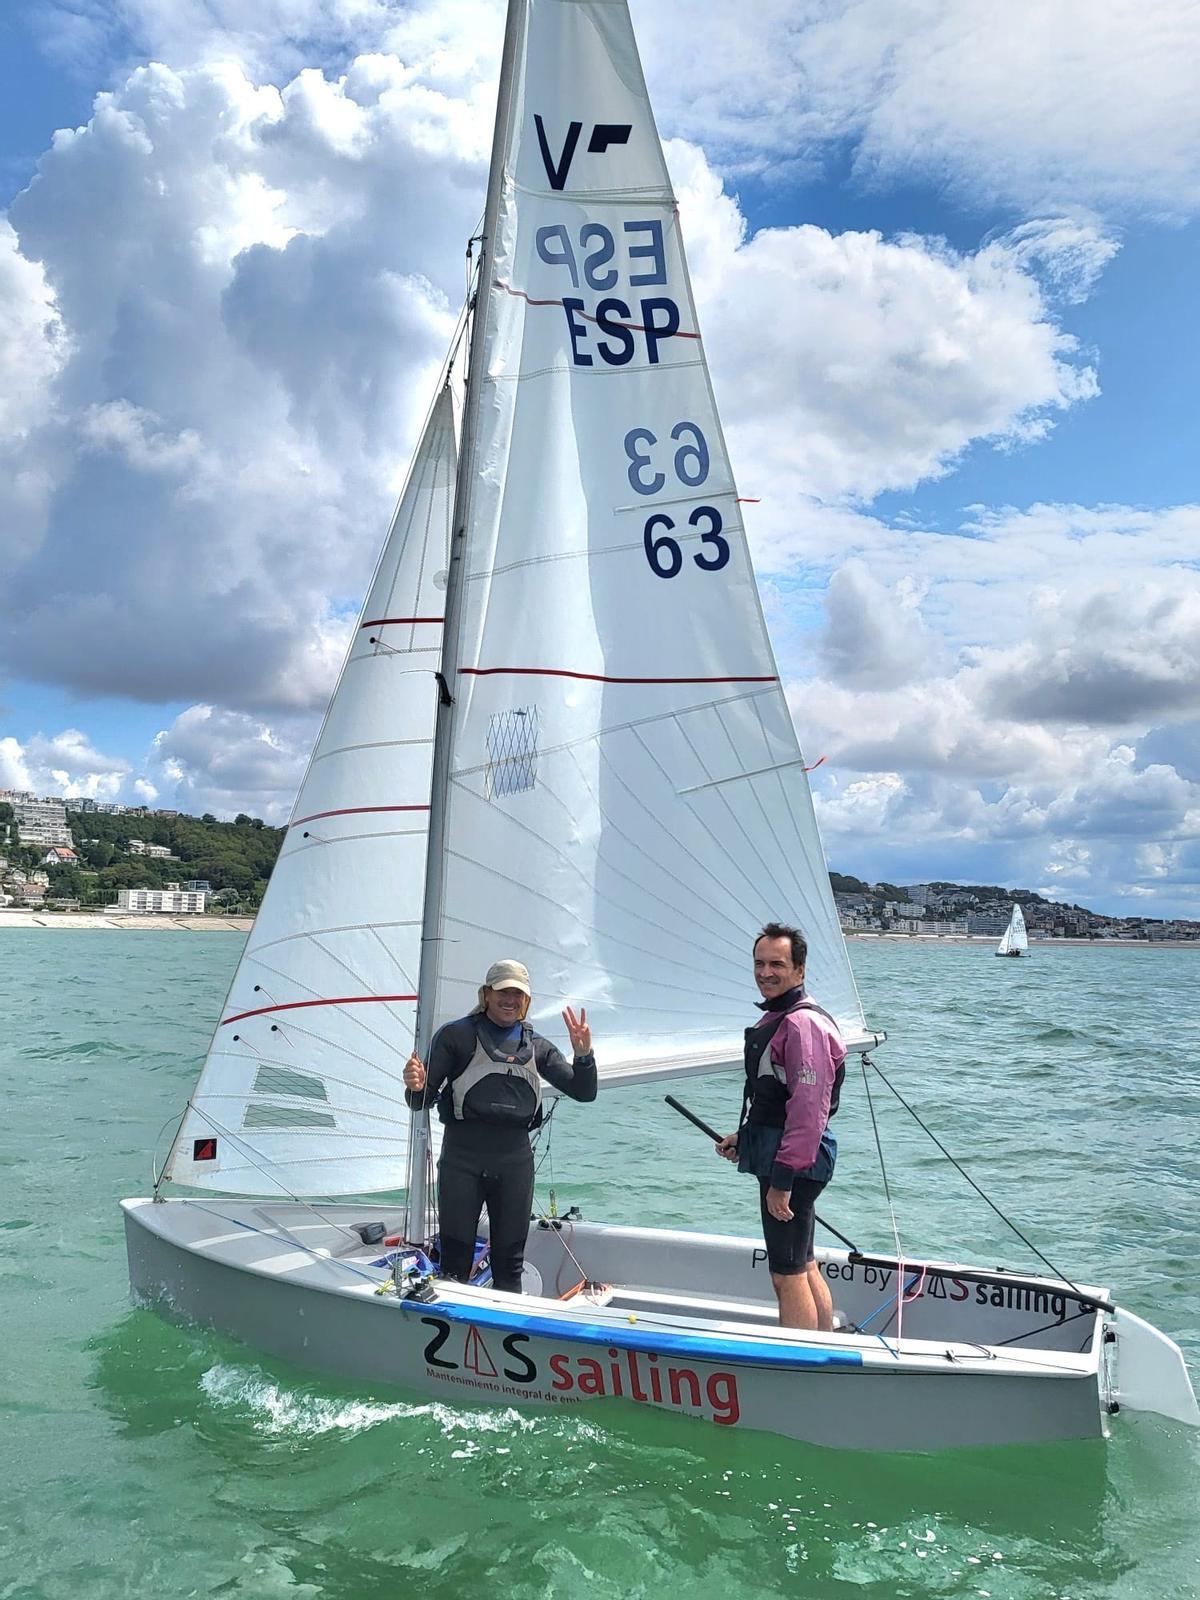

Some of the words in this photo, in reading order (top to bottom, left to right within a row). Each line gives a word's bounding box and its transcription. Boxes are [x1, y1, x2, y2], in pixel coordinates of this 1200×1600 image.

[563, 297, 680, 366] ESP
[643, 506, 730, 579] 63
[752, 1248, 854, 1281] Pred
[864, 1263, 892, 1291] by
[976, 1283, 1066, 1321] sailing
[426, 1368, 500, 1392] Mantenimiento
[502, 1384, 542, 1400] integral
[544, 1392, 557, 1403] de
[550, 1347, 740, 1425] sailing
